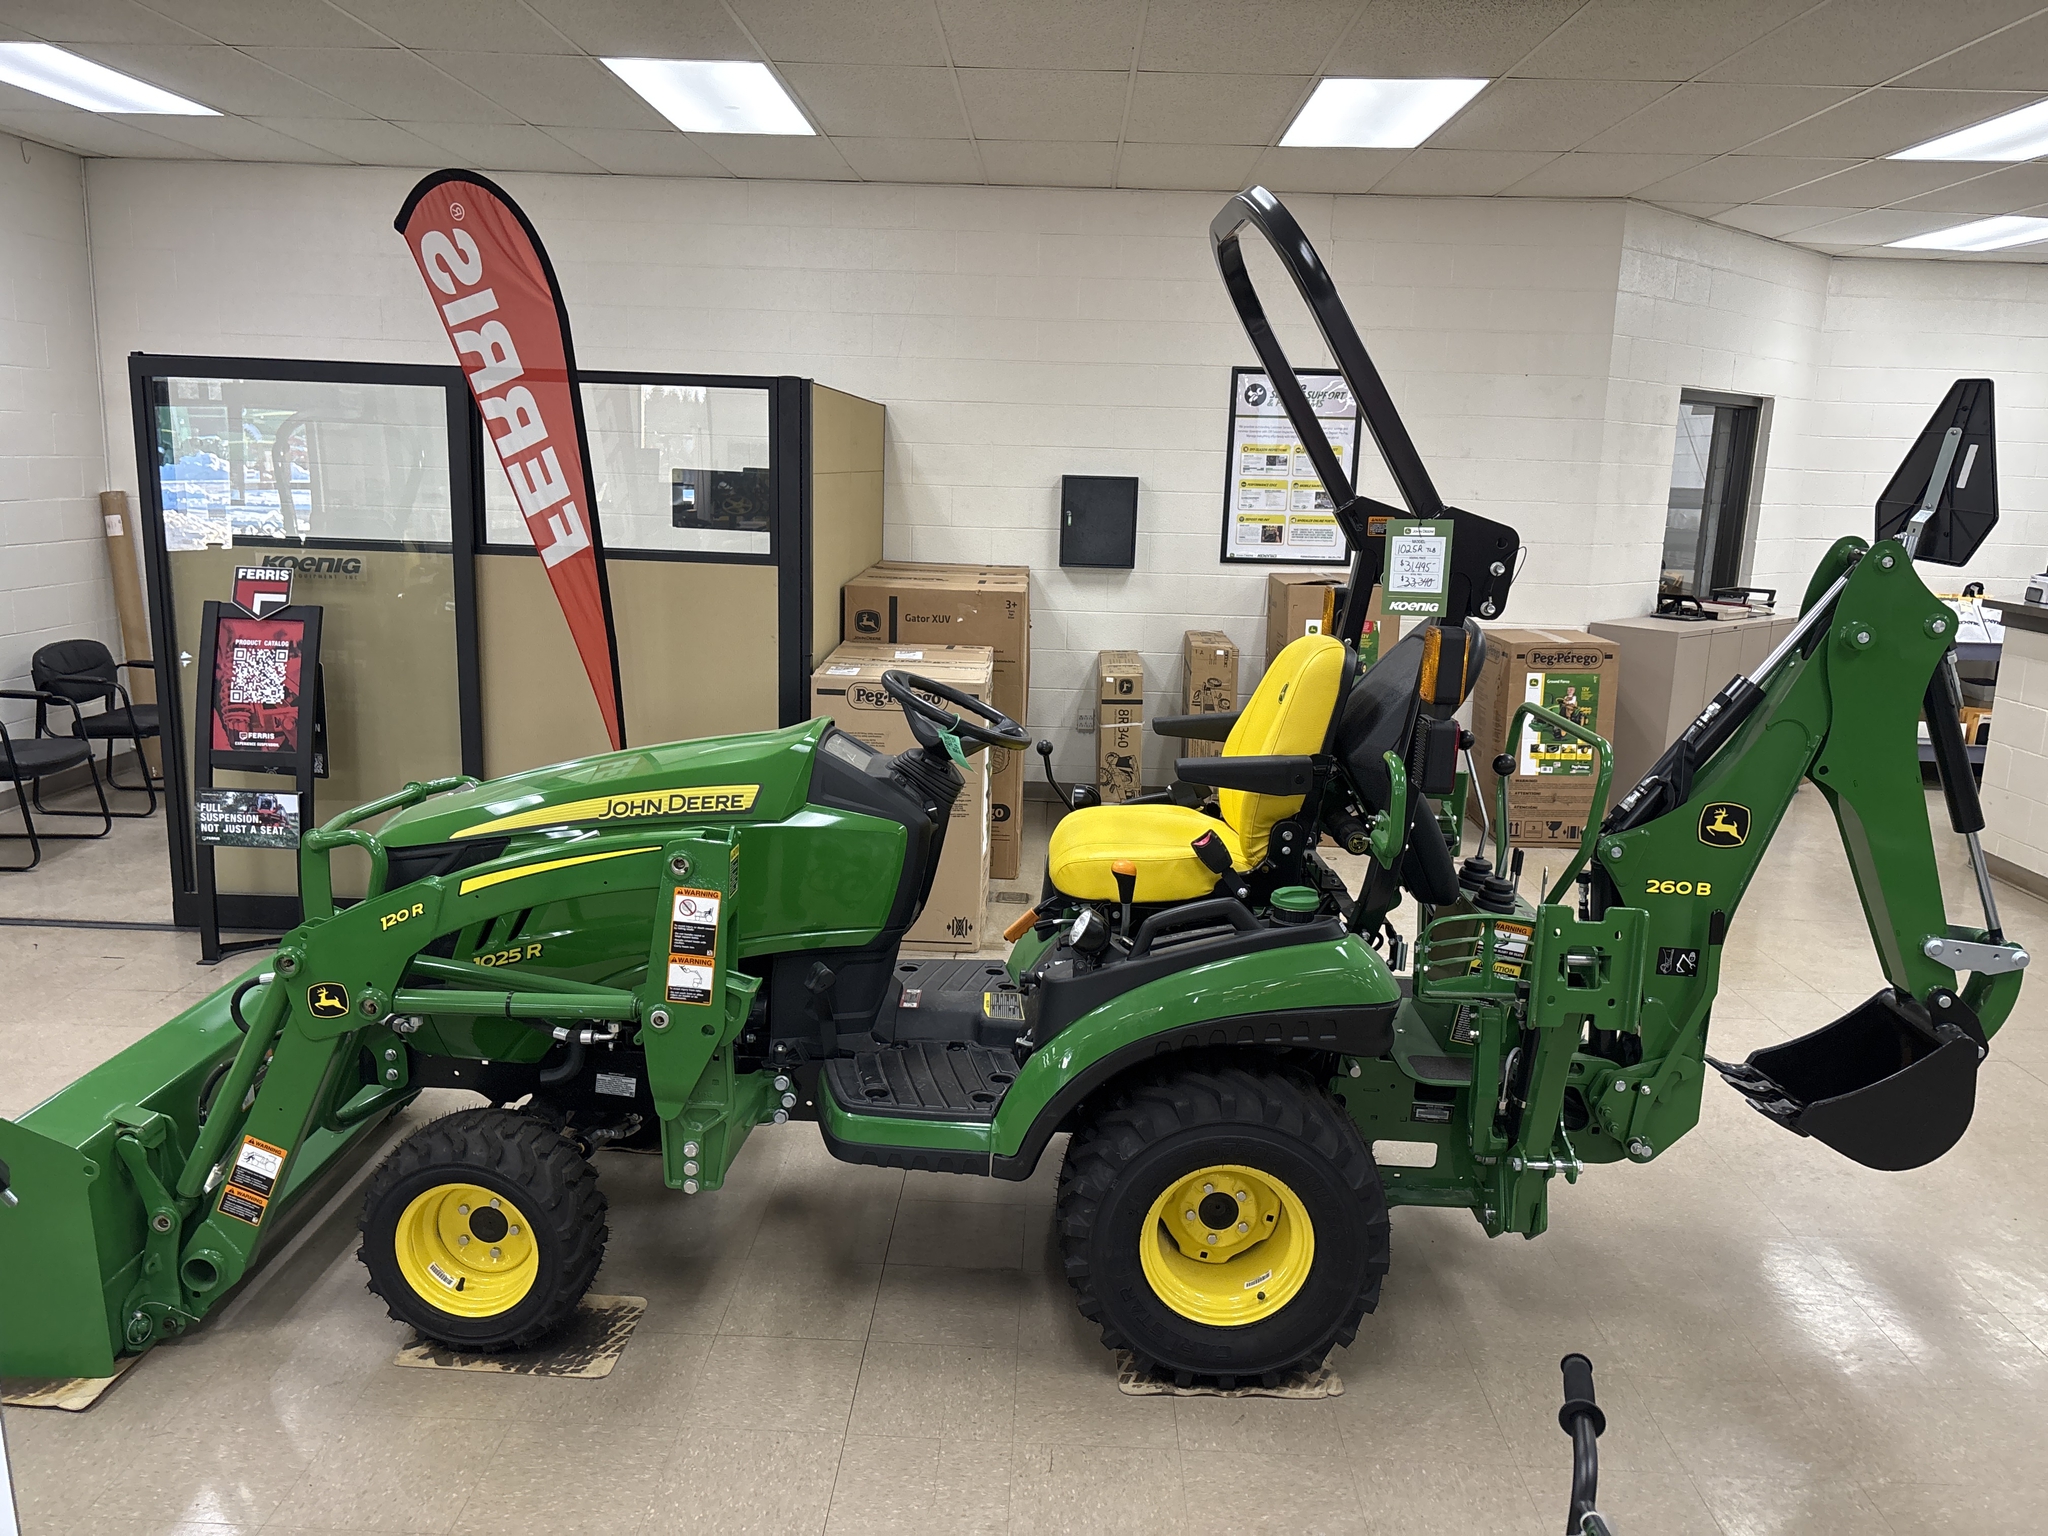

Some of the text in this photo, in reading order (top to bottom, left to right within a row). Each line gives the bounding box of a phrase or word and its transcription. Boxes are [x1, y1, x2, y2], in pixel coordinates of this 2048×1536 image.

[237, 568, 290, 581] FERRIS
[1005, 600, 1018, 609] 3+
[904, 613, 951, 623] Gator XUV
[1117, 709, 1130, 749] 8R340
[248, 732, 275, 740] FERRIS
[200, 803, 223, 812] FULL
[599, 794, 744, 818] JOHN DEERE
[200, 813, 262, 824] SUSPENSION.
[200, 824, 286, 836] NOT JUST A SEAT.
[1646, 879, 1712, 896] 260 B
[684, 889, 719, 899] WARNING
[380, 903, 424, 931] 120 R
[1495, 923, 1528, 935] WARNING
[473, 943, 542, 967] 1025 R
[678, 957, 712, 967] WARNING
[1494, 965, 1515, 974] UTION
[255, 1140, 282, 1155] WARNING
[236, 1190, 263, 1205] WARNING
